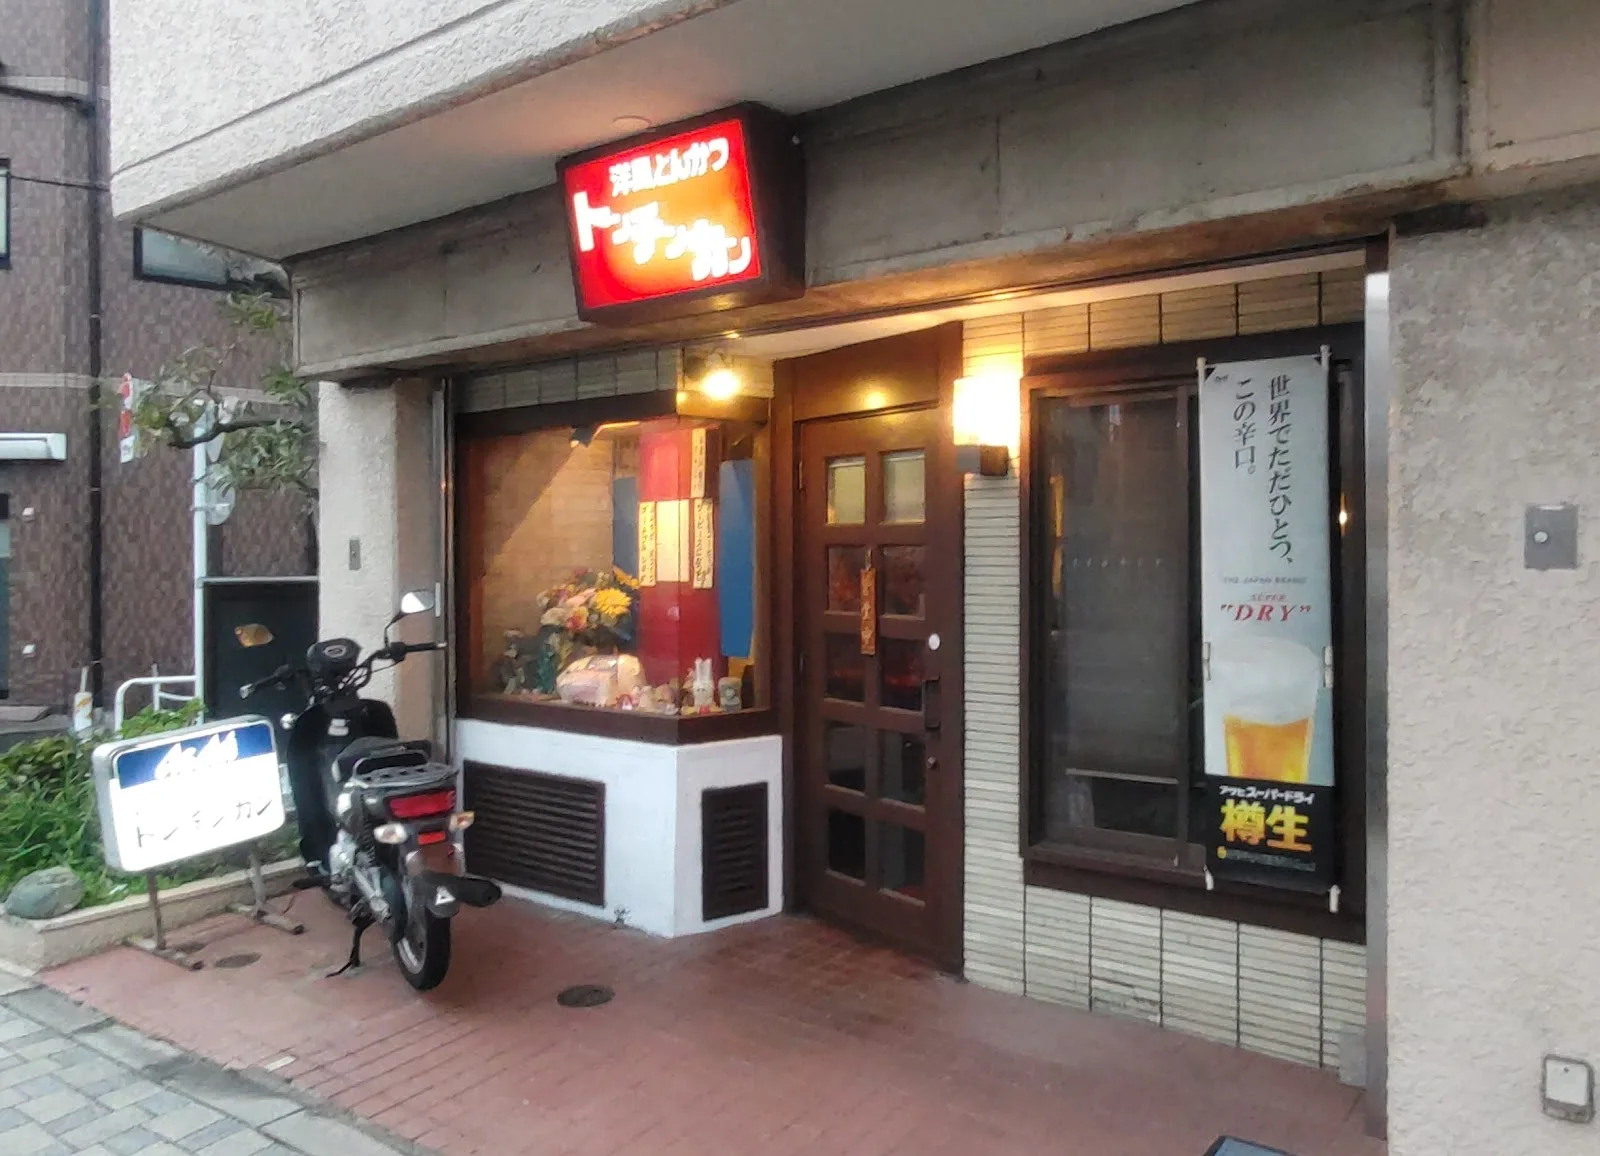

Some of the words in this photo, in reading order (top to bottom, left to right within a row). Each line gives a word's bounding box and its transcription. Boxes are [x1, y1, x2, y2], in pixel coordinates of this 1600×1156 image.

[1233, 378, 1257, 475] この辛口。
[1267, 374, 1294, 563] 世界でただひとつ、
[1220, 798, 1313, 852] 樽生
